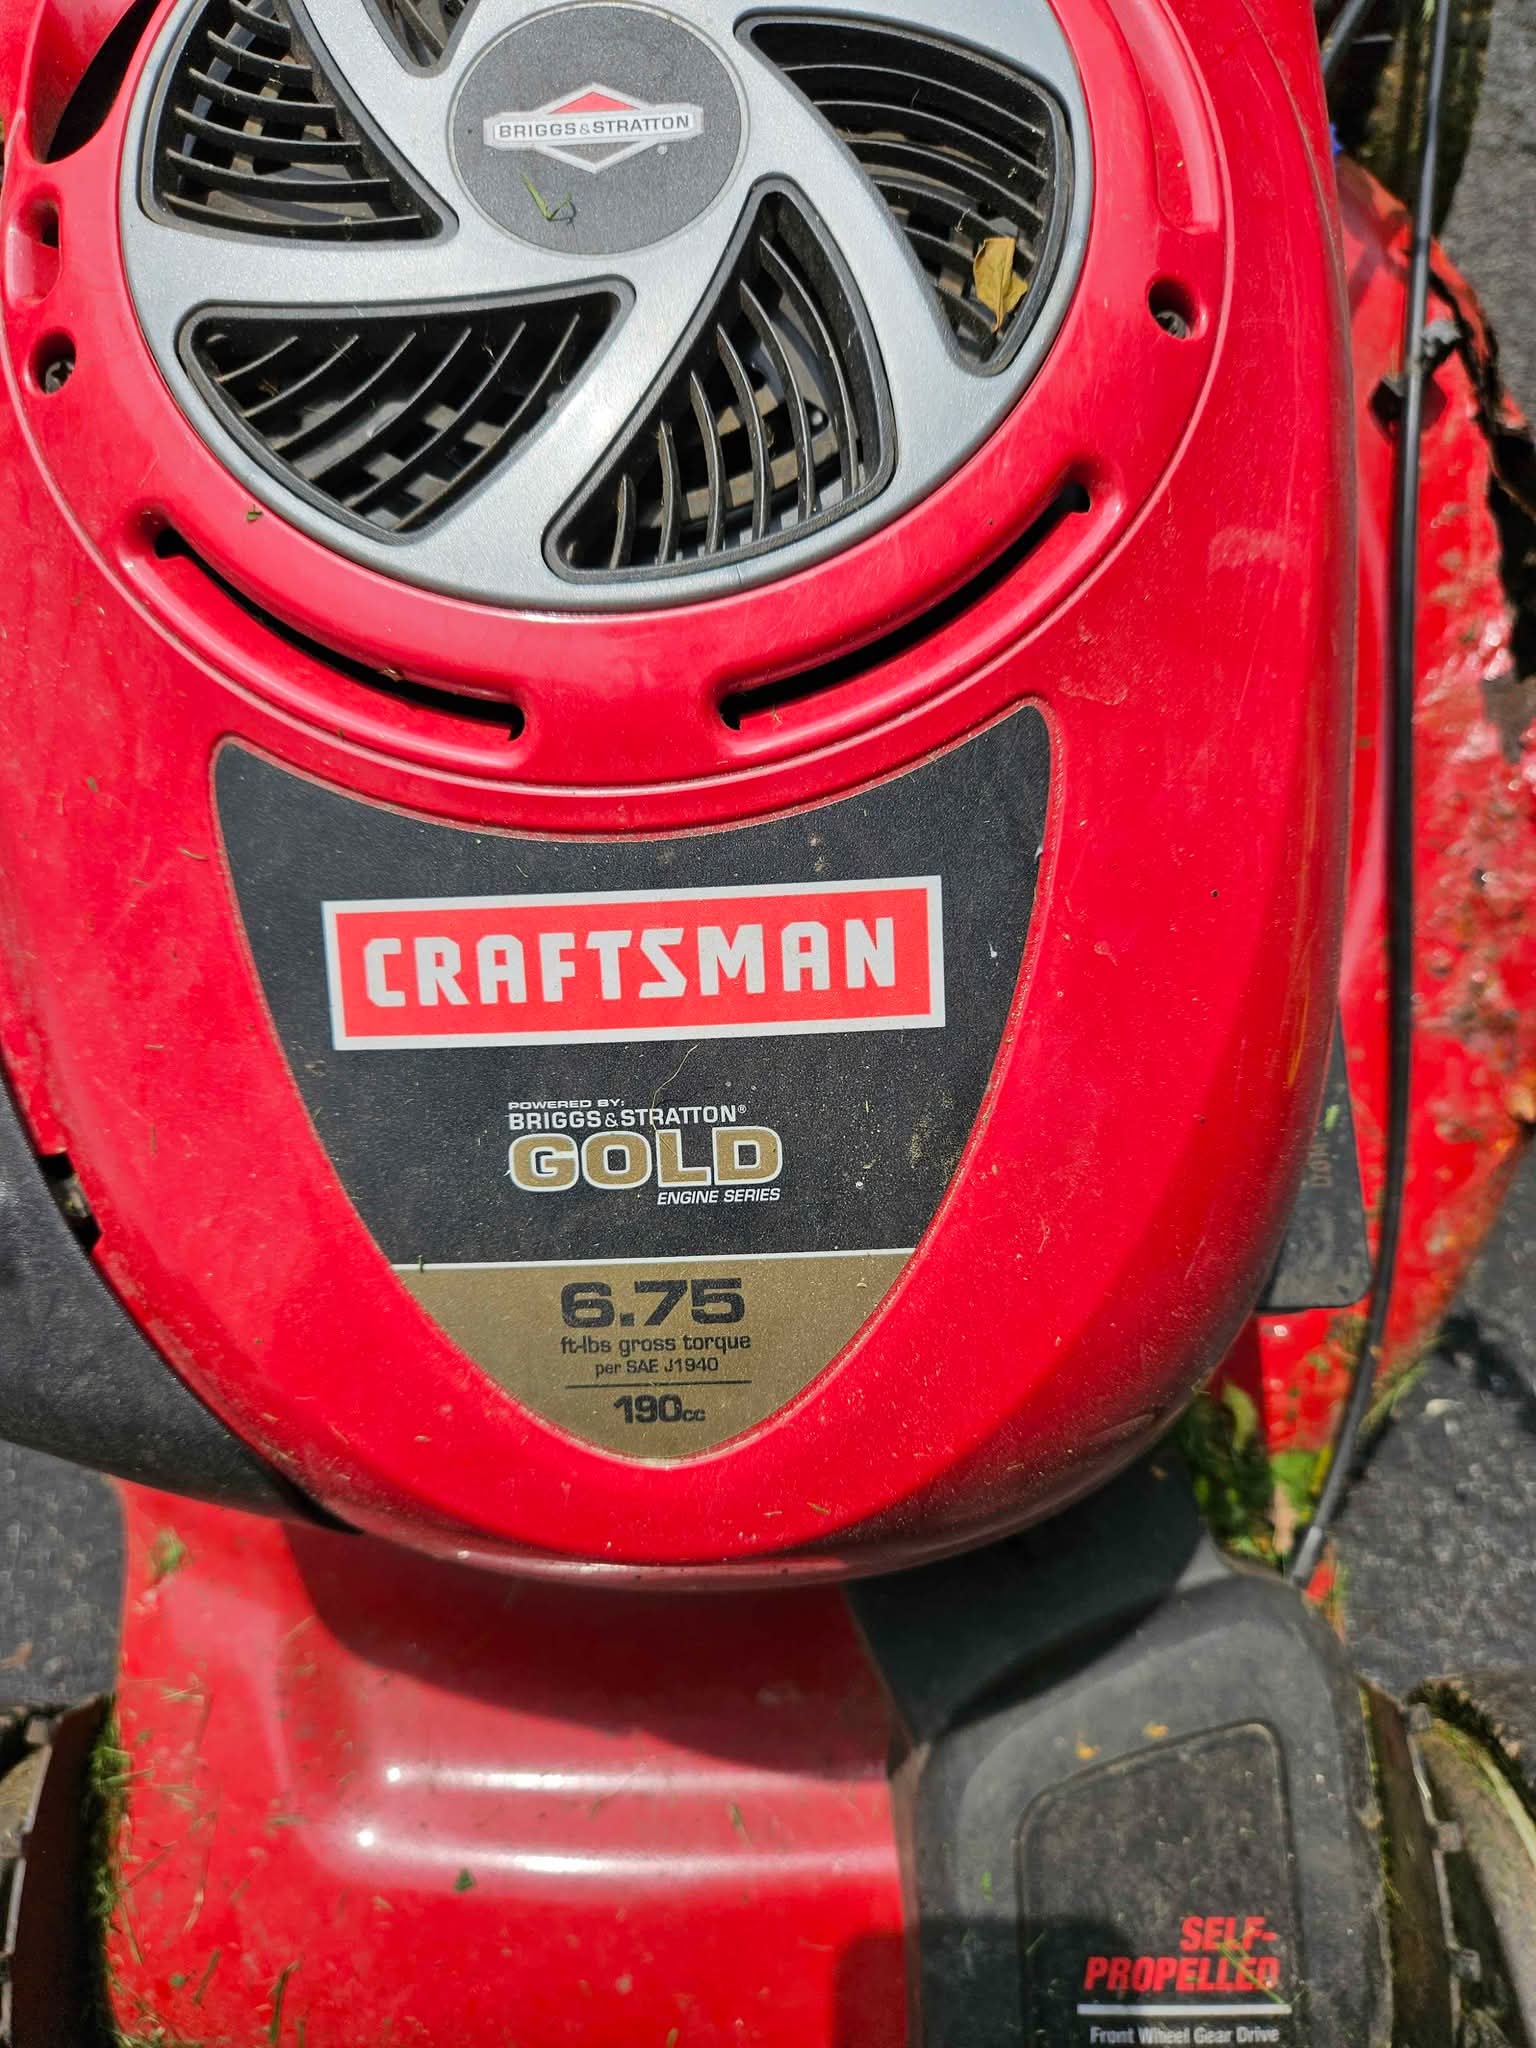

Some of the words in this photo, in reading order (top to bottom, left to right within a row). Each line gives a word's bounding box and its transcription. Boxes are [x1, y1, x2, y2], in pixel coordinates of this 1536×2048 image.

[364, 917, 896, 1008] CRAFTSMAN
[508, 1099, 592, 1110] POWERED
[597, 1098, 625, 1108] BY:
[508, 1126, 783, 1192] GOLD
[657, 1190, 719, 1206] ENGINE
[723, 1188, 781, 1203] SERIES
[560, 1278, 745, 1329] 6.75
[560, 1335, 612, 1354] ft-lbs
[618, 1336, 676, 1358] gross
[683, 1334, 751, 1354] torque
[595, 1363, 622, 1377] per
[626, 1359, 659, 1374] SAE
[664, 1357, 719, 1373] J1940
[613, 1393, 706, 1424] 190cc
[1179, 1915, 1278, 1952] SELF-
[1083, 1956, 1281, 1992] PROPELLED
[1090, 2026, 1136, 2045] Front
[1138, 2026, 1191, 2045] Wheel
[1194, 2026, 1233, 2045] Gear
[1236, 2025, 1280, 2044] Drive
